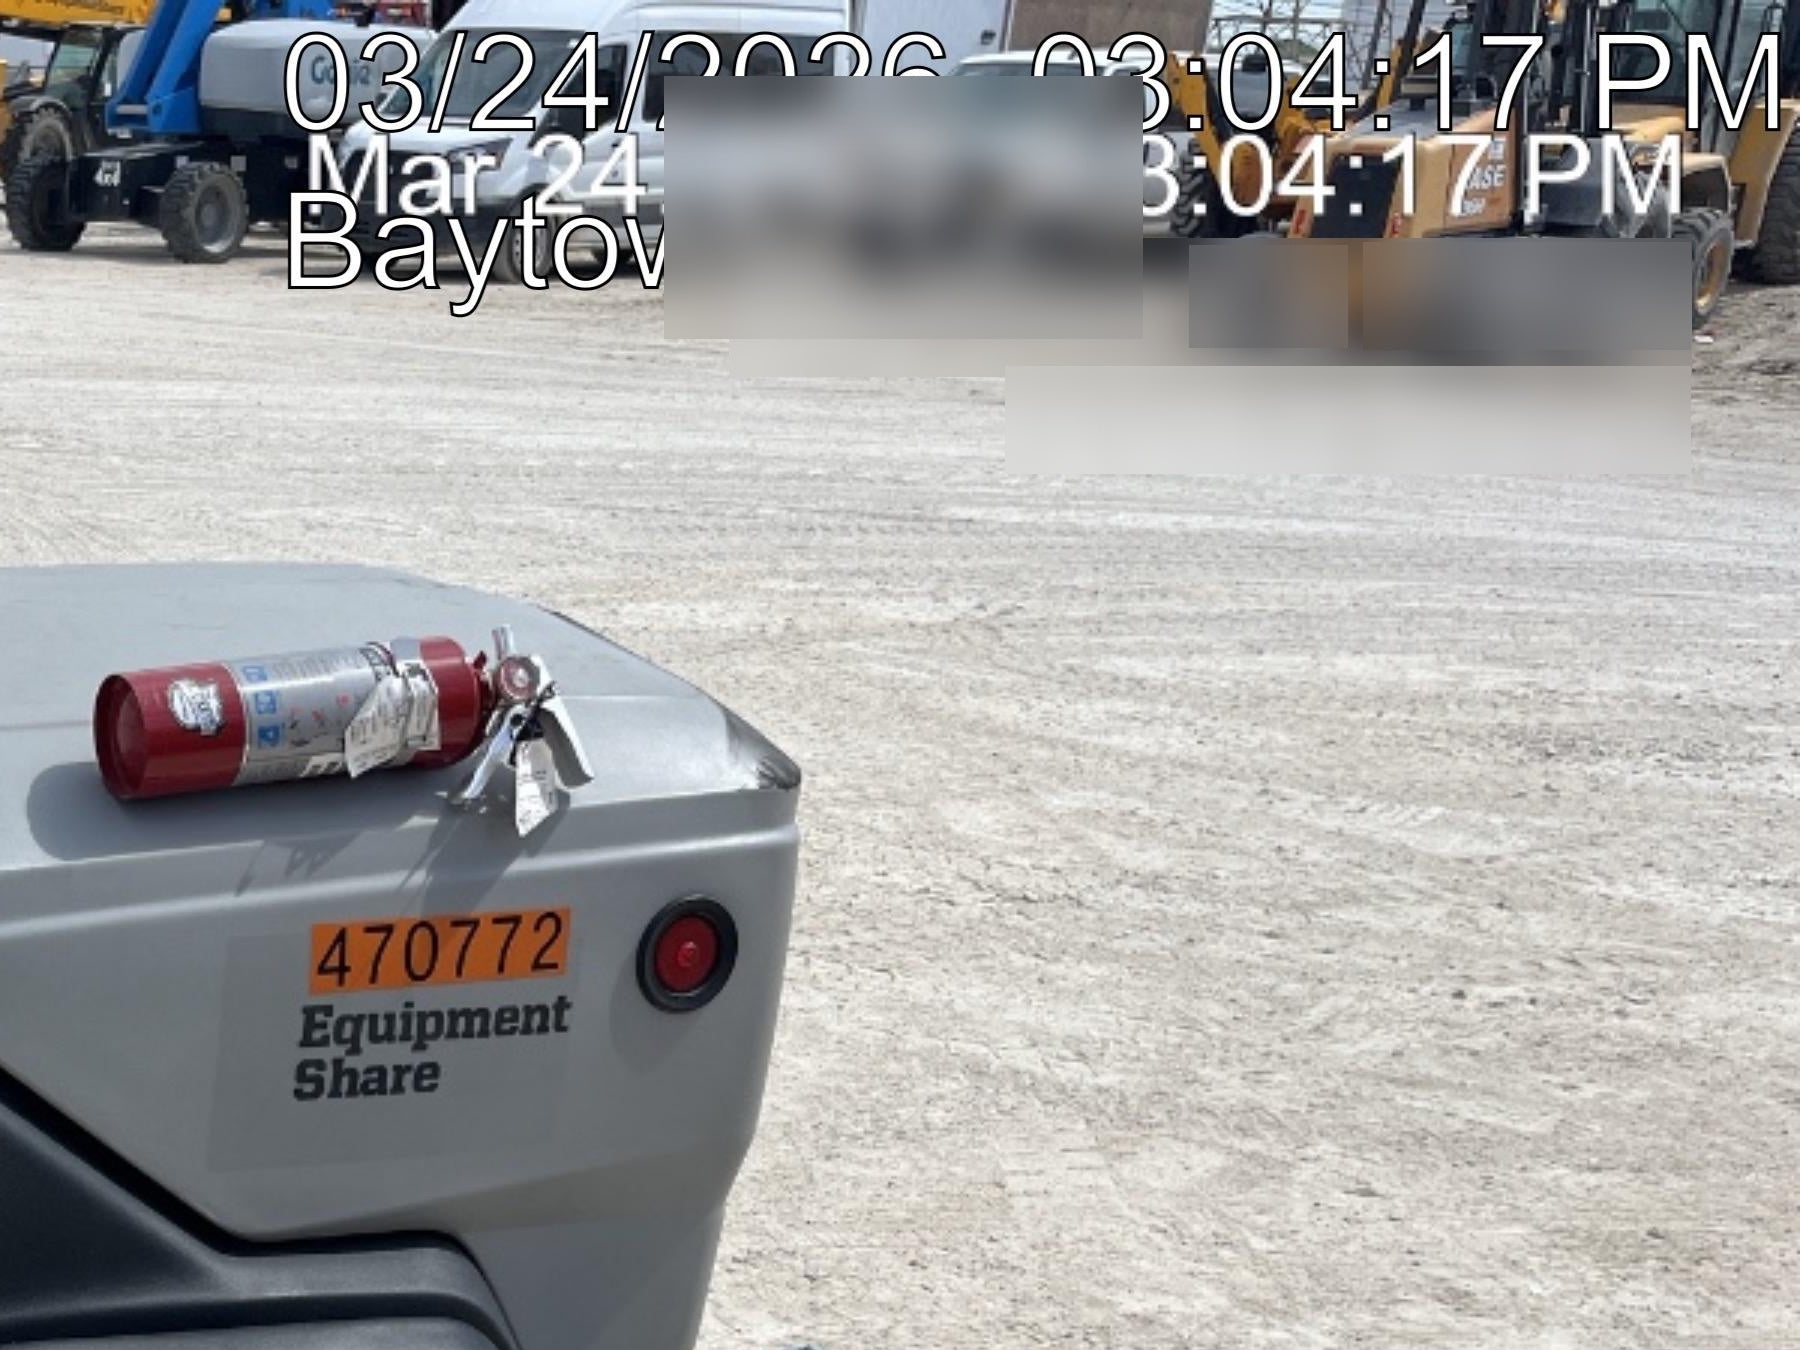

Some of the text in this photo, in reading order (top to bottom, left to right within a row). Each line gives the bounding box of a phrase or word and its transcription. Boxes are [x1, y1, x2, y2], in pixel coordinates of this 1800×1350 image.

[1468, 163, 1507, 191] ASE
[315, 910, 564, 988] 470772
[298, 996, 573, 1056] Equipment
[293, 1055, 442, 1101] Share
